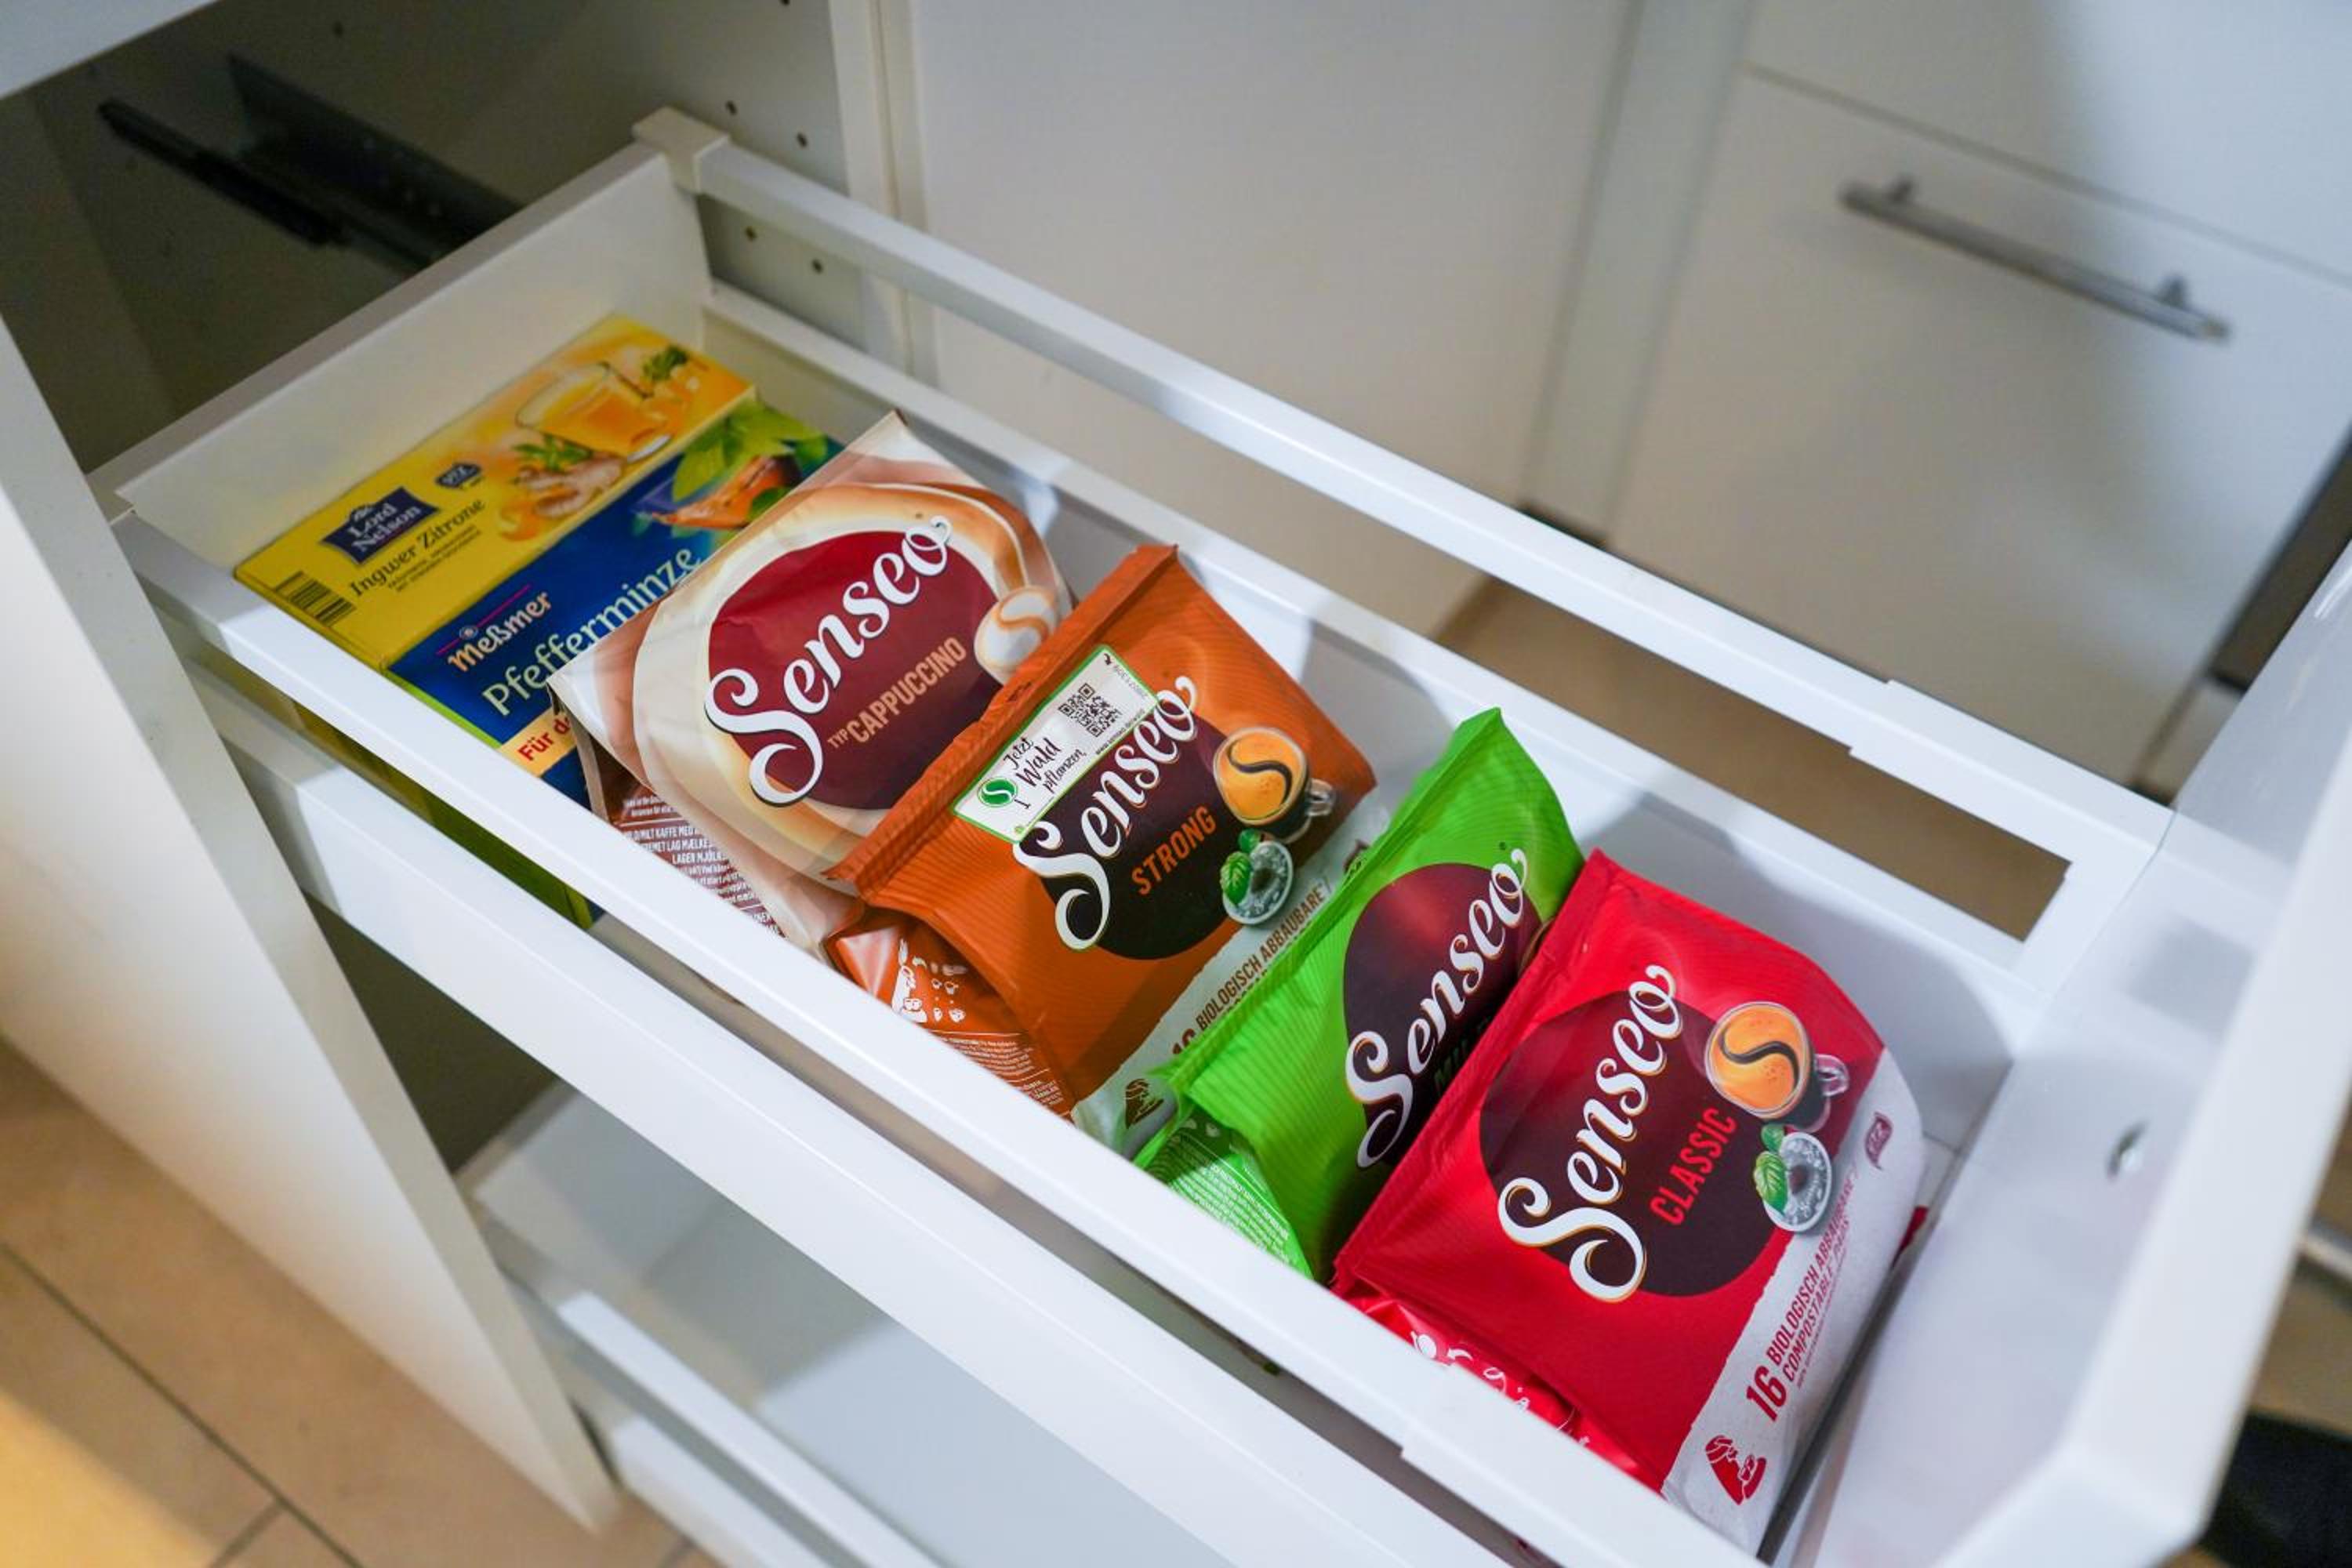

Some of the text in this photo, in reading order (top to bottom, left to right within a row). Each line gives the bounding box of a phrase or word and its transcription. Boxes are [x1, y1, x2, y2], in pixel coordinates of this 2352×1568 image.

[347, 503, 397, 538] Lord
[349, 545, 417, 597] Ingwer
[416, 499, 486, 549] Zitrone
[352, 506, 422, 553] Nelson
[482, 548, 705, 717] Pfefferminze
[706, 516, 953, 806] Senseo
[517, 715, 571, 763] Für d
[826, 636, 967, 750] TYP CAPPUCCINO
[1004, 733, 1034, 771] Jetzt
[1015, 737, 1062, 788] Wald
[1013, 675, 1200, 951] Senseo
[1131, 804, 1218, 896] STRONG
[1196, 953, 1263, 1041] BIOLOGISCH
[1345, 847, 1529, 1169] Senseo
[1498, 964, 1684, 1301] Senseo
[1650, 1105, 1738, 1229] CLASSIC
[1766, 1267, 1819, 1364] BIOLOGISCH
[1746, 1364, 1788, 1422] 16
